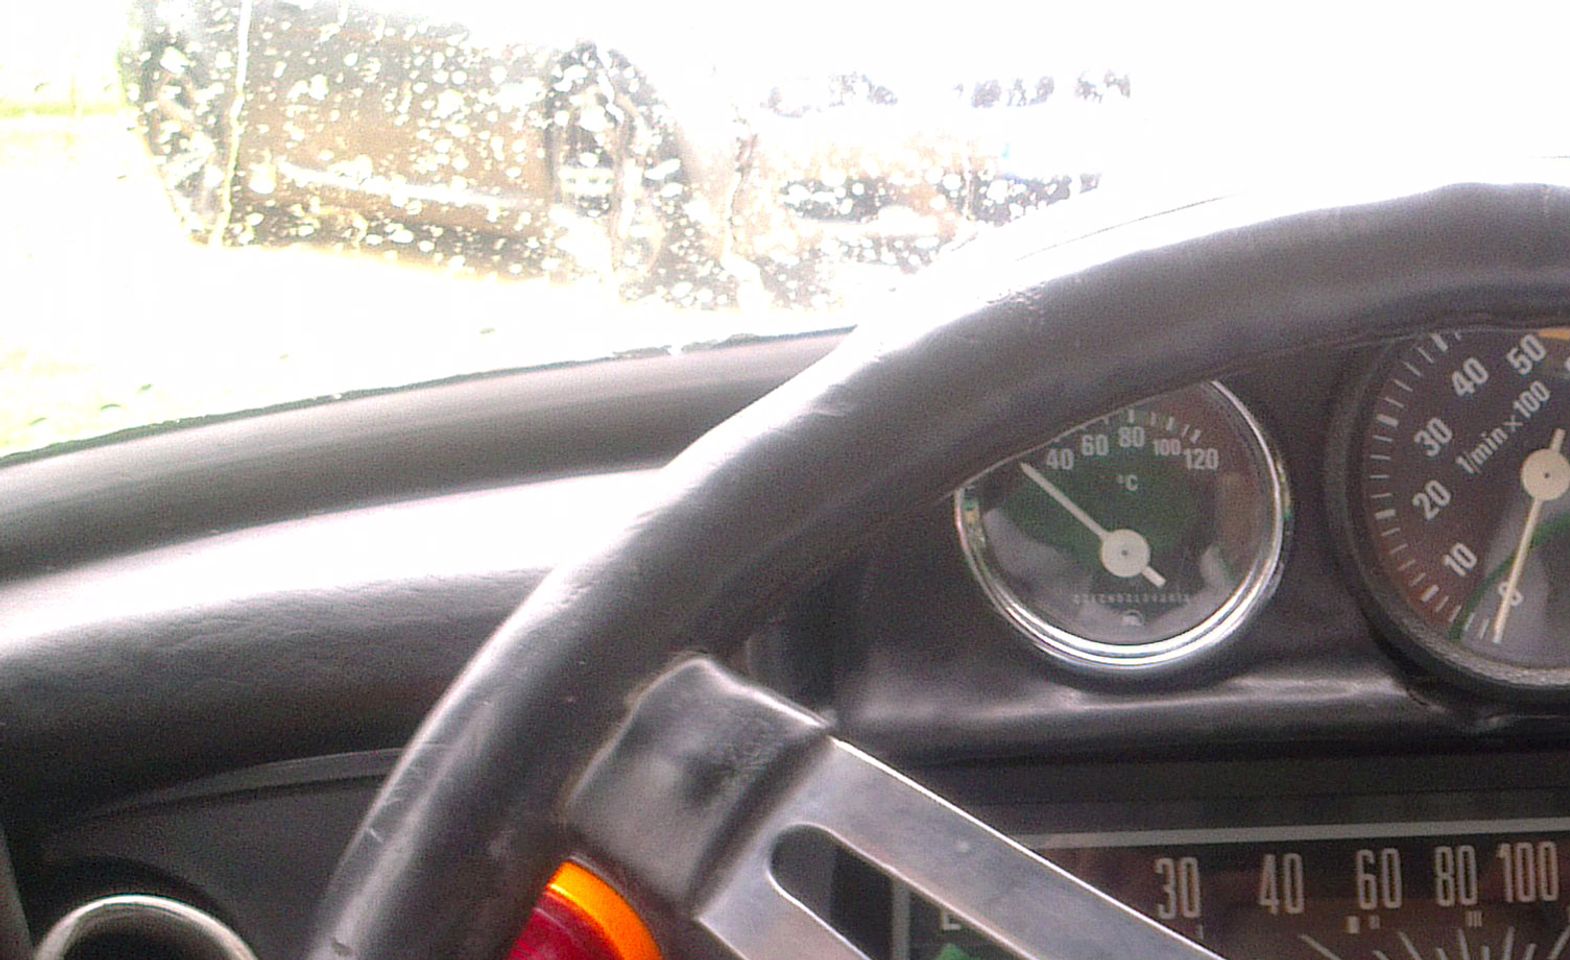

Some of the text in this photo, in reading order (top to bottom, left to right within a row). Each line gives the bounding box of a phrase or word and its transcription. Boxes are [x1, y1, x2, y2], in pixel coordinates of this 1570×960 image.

[1506, 334, 1546, 375] 50
[1450, 357, 1489, 397] 40
[1081, 434, 1109, 456] 60
[1118, 426, 1145, 448] 80
[1153, 439, 1181, 456] 100
[1414, 417, 1453, 458] 30
[1046, 448, 1074, 471] 40
[1185, 449, 1219, 470] 120
[1412, 479, 1452, 521] 20
[1443, 542, 1478, 578] 10
[1154, 856, 1199, 919] 30
[1259, 852, 1303, 914] 40
[1356, 848, 1401, 910] 60
[1434, 845, 1478, 907] 80
[1497, 841, 1559, 903] 100
